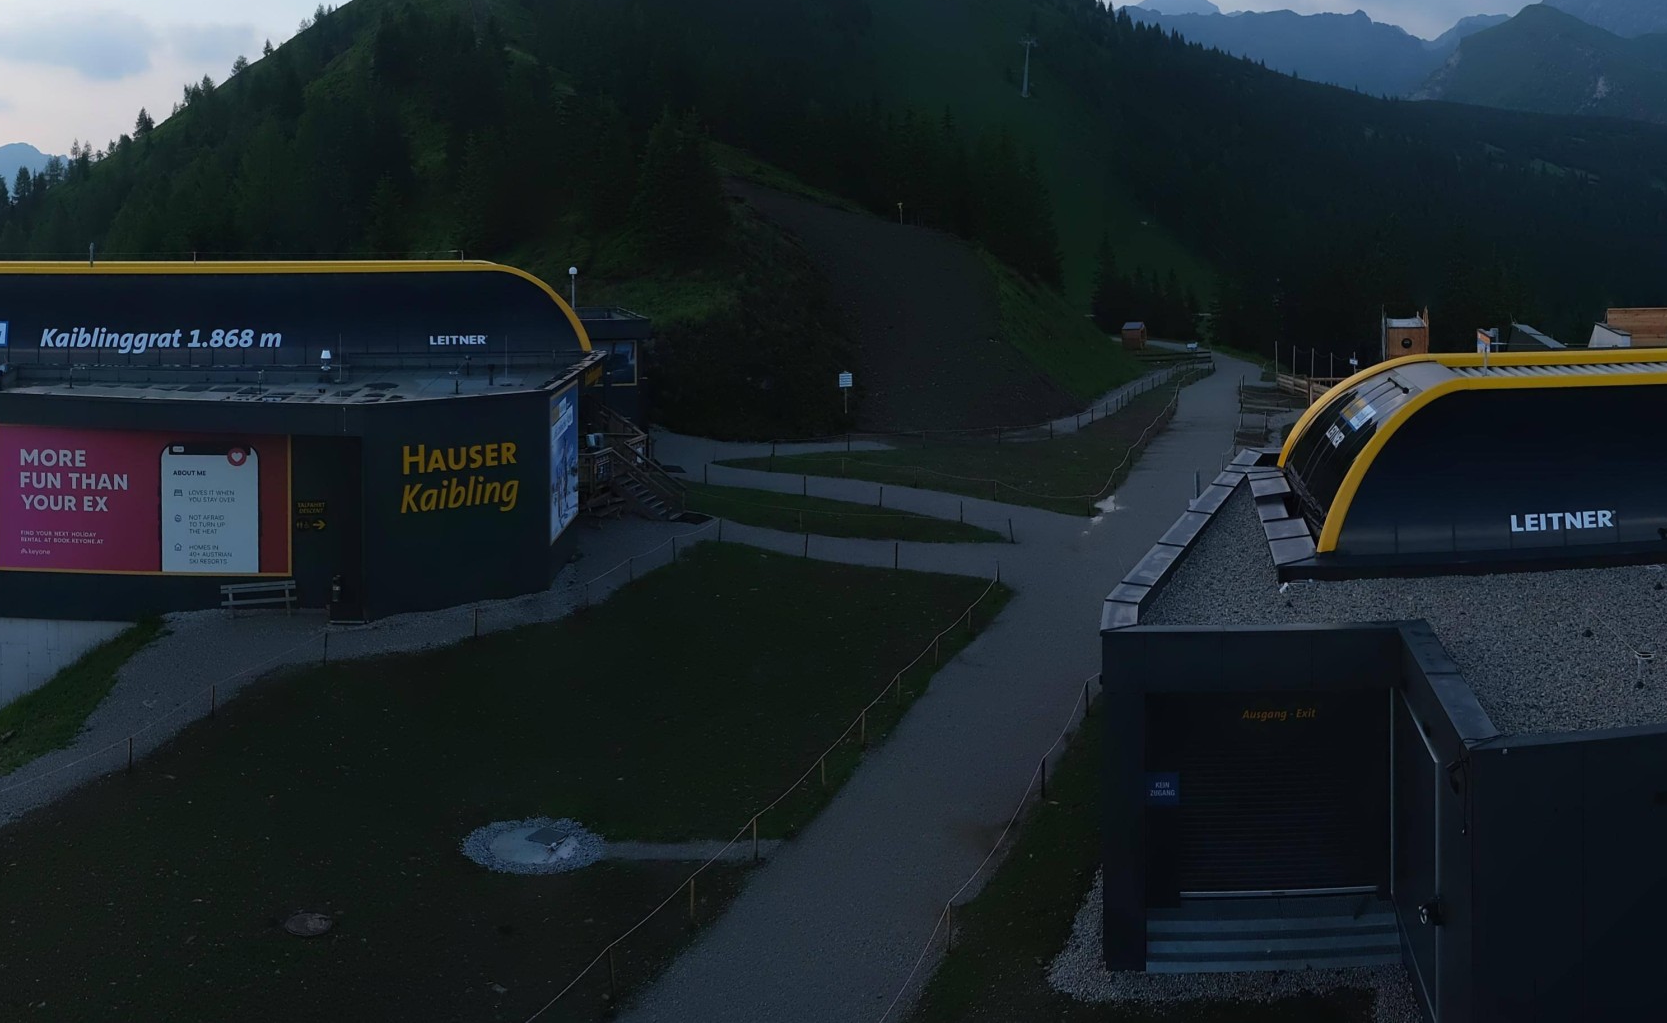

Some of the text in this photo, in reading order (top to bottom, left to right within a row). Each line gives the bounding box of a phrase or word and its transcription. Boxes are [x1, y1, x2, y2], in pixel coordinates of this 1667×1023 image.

[40, 327, 282, 354] Kaiblinggrat 1.868 m
[429, 335, 488, 345] LEITNER
[20, 448, 87, 467] MORE
[402, 441, 517, 475] HAUSER
[20, 471, 128, 490] FUN THAN
[21, 494, 108, 512] YOUR EX
[400, 475, 520, 514] Kaibling
[1510, 509, 1615, 532] LEITNER
[28, 548, 51, 556] keyone
[1241, 709, 1288, 722] Ausgang
[1296, 708, 1317, 718] Exit
[1150, 789, 1176, 797] ZUGANG
[1155, 781, 1170, 789] KEIN
